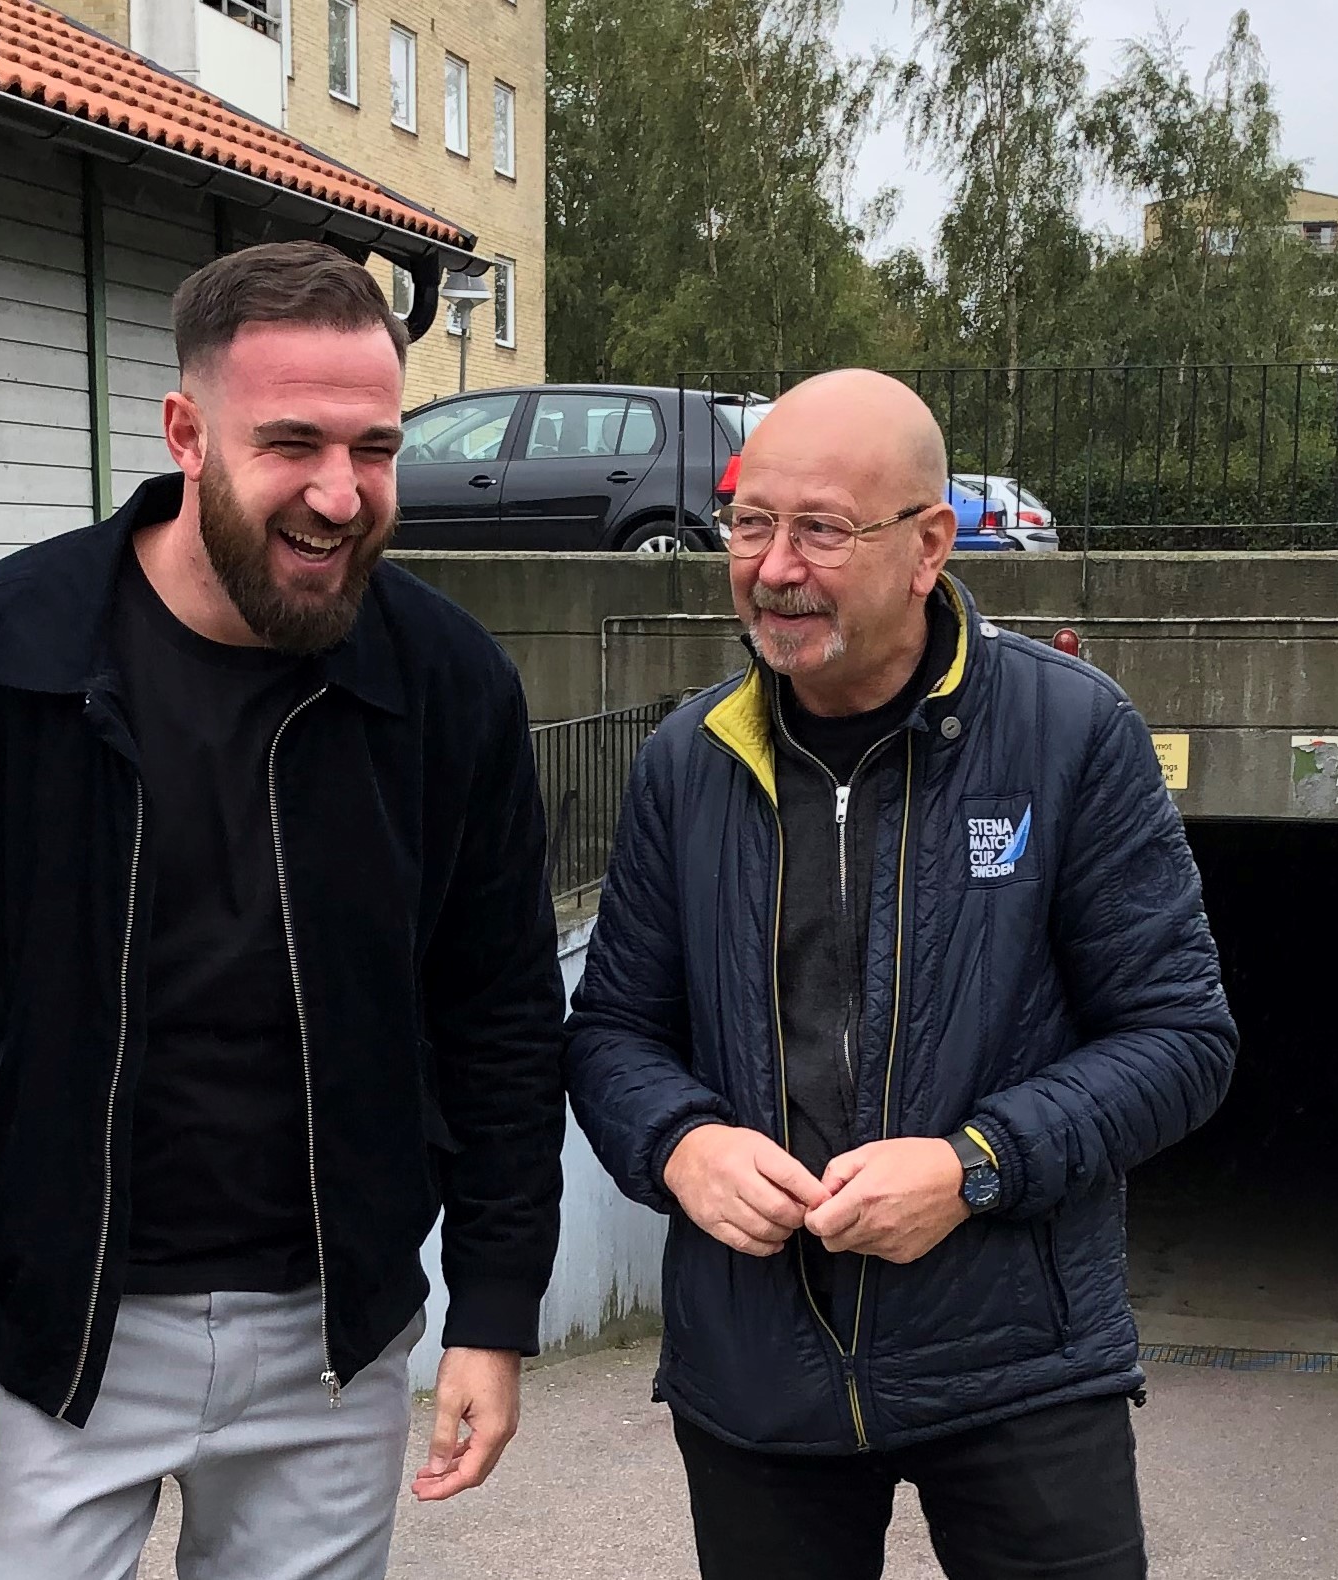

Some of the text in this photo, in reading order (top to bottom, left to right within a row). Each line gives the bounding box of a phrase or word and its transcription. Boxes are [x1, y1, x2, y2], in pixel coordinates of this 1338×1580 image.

[968, 818, 1013, 835] STENA
[969, 834, 1015, 850] MATCH
[970, 850, 995, 865] CUP
[971, 861, 1015, 878] SWEDEN
